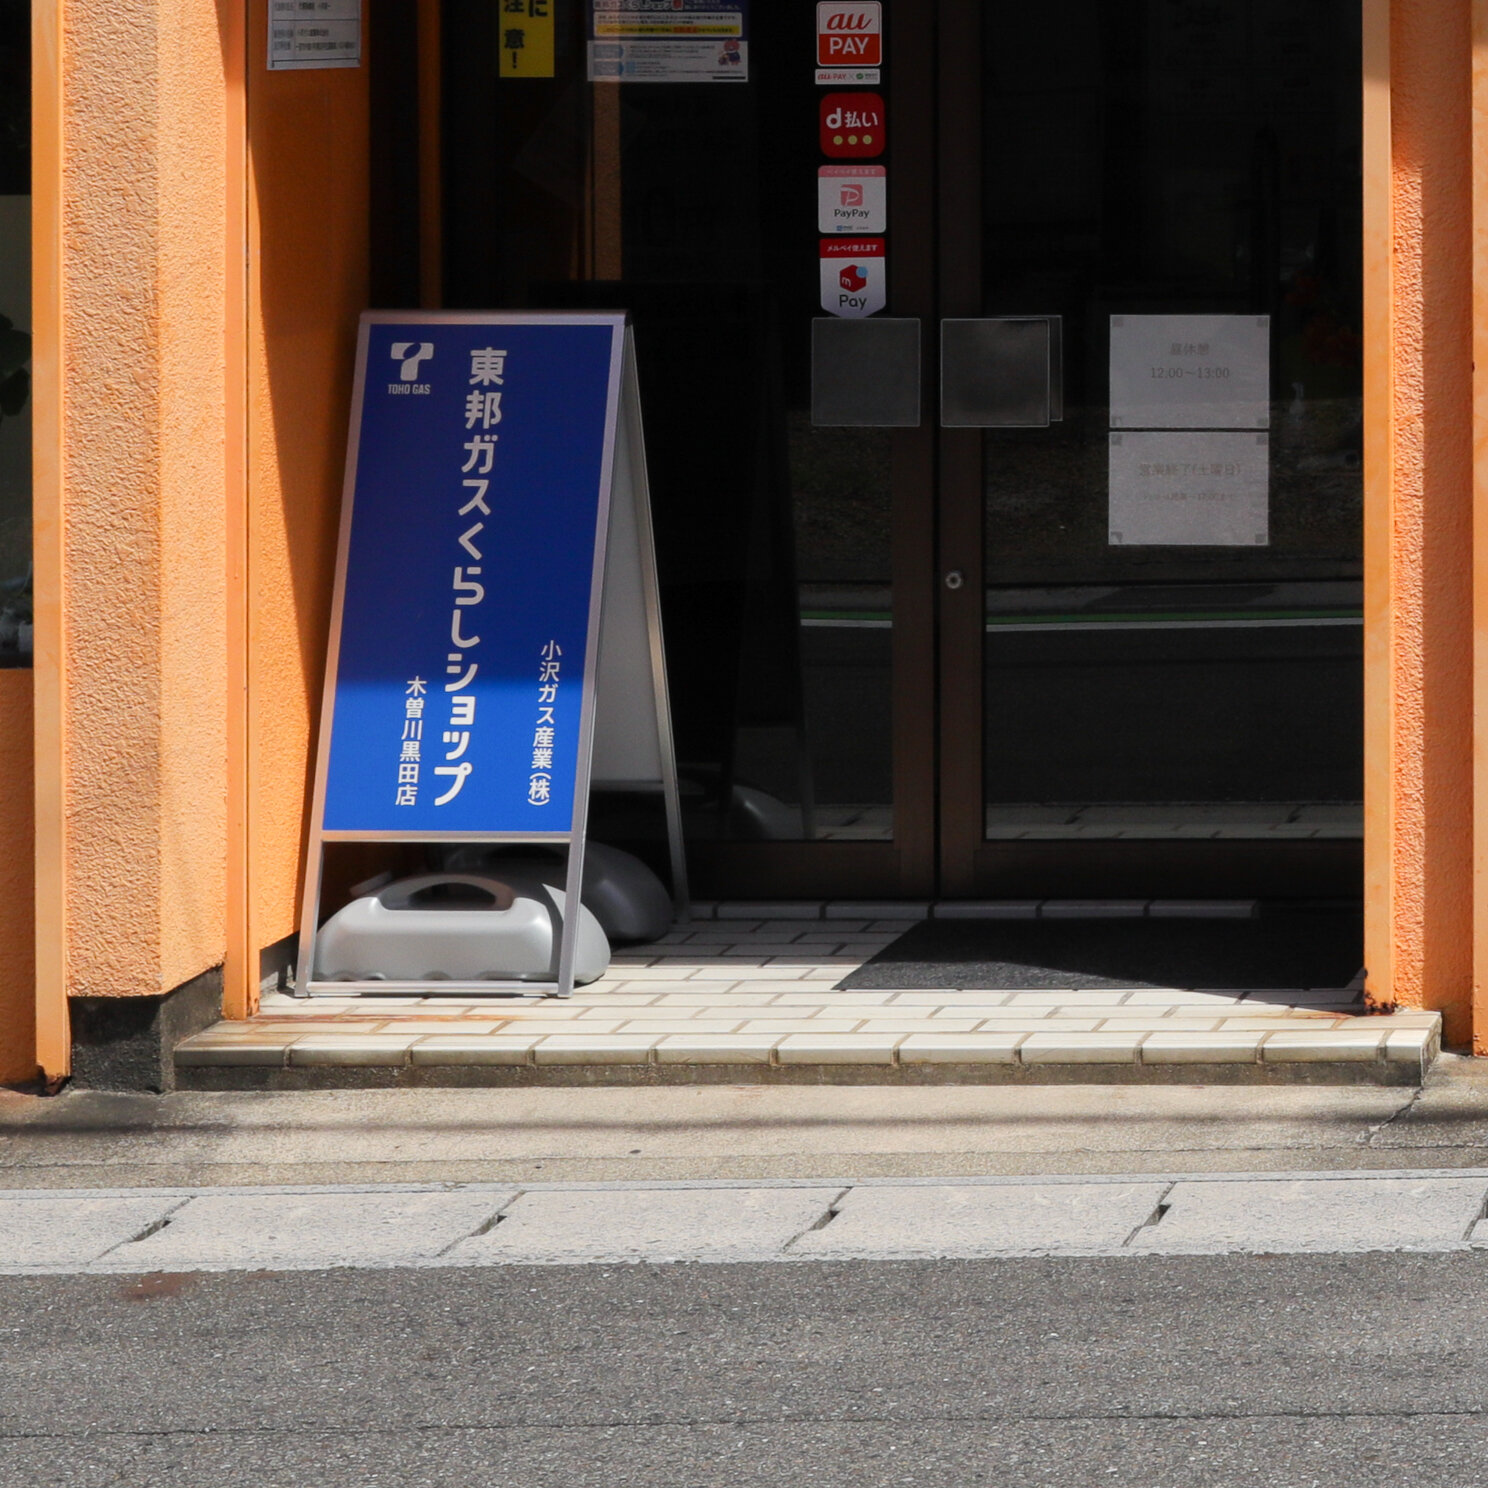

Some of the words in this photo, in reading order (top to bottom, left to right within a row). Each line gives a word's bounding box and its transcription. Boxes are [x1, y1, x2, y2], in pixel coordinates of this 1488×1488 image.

[827, 13, 872, 30] au
[829, 37, 869, 54] PAY
[826, 107, 878, 129] d払い
[834, 209, 869, 219] PayPay
[839, 294, 867, 310] Pay
[388, 384, 409, 395] TOHO
[412, 385, 430, 395] GAS
[434, 347, 507, 806] 東邦ガスくらしショップ
[527, 640, 561, 806] 小沢ガス産業(株)
[395, 676, 427, 806] 木曽川黒田店
